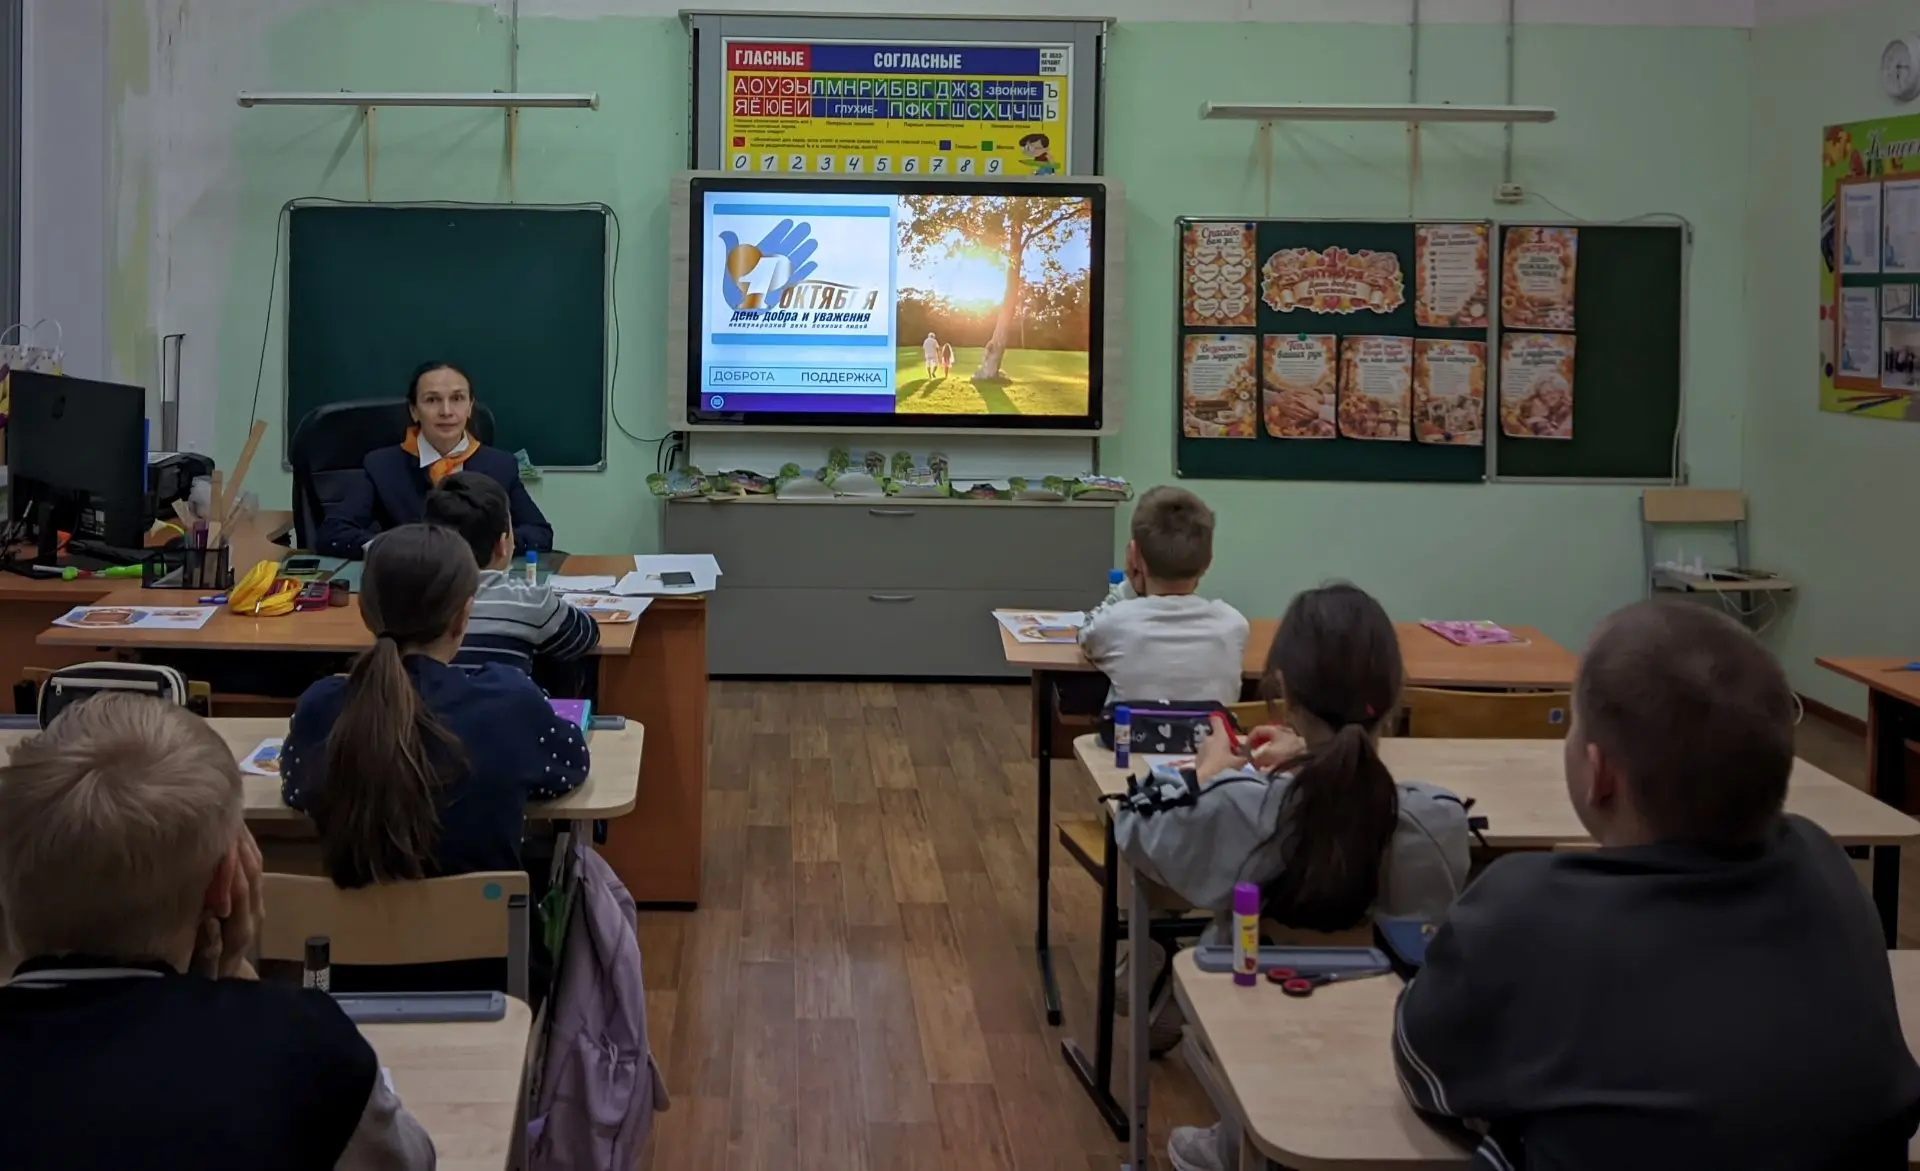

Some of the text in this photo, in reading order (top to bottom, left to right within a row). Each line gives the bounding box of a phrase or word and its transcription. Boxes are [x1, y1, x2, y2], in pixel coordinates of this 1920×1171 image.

[735, 50, 805, 66] ГЛАСНЫЕ
[873, 52, 962, 69] СОГЛАСНЫЕ
[735, 155, 999, 173] 0 1 2 3 4 5 6 7 8 9
[1201, 227, 1239, 239] Спасибо
[762, 310, 797, 322] добра
[802, 313, 809, 321] и
[813, 312, 871, 323] уважения
[714, 371, 882, 384] ДОБРОТА ПОДДЕРЖКА
